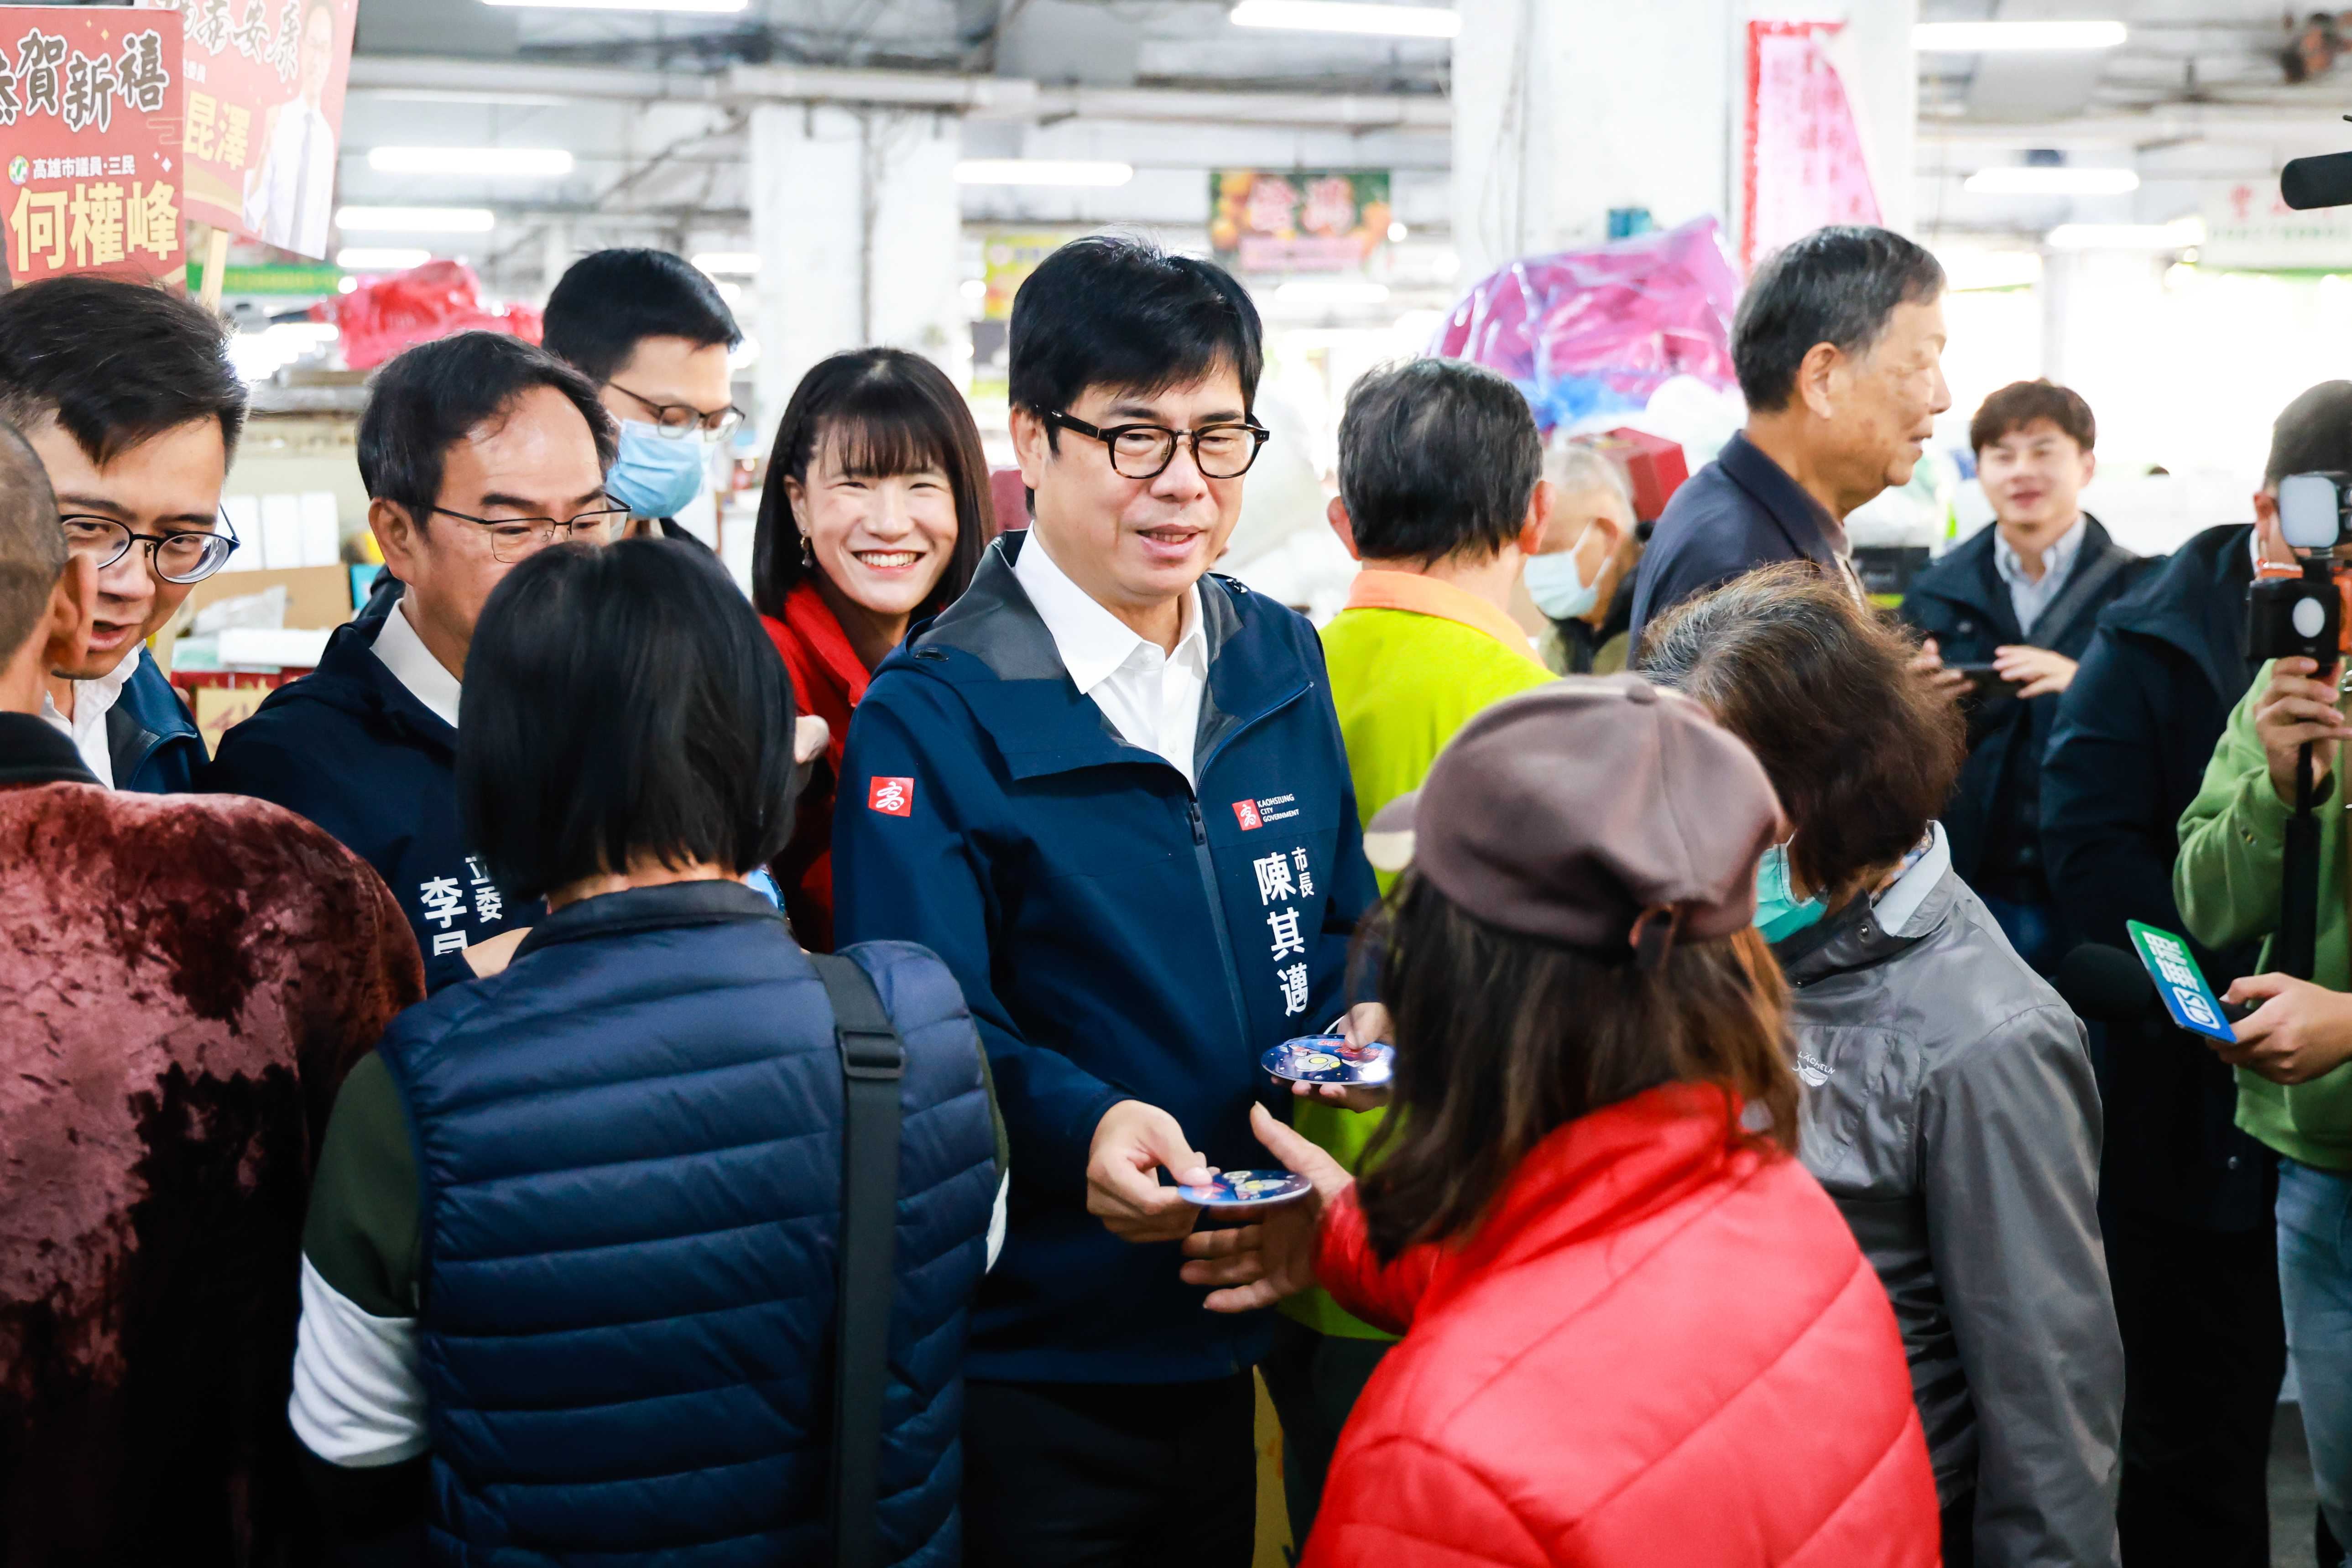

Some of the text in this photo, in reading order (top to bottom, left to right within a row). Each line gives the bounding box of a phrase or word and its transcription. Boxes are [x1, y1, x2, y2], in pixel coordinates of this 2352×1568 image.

[10, 181, 179, 272] 何權峰
[1257, 793, 1295, 808] KAOHSIUNG
[1260, 807, 1273, 815] CITY
[1262, 808, 1299, 822] GOVERNMENT
[1292, 846, 1314, 899] 市長
[1253, 851, 1309, 1017] 陳其邁
[1798, 1051, 1835, 1074] LÄCHELN
